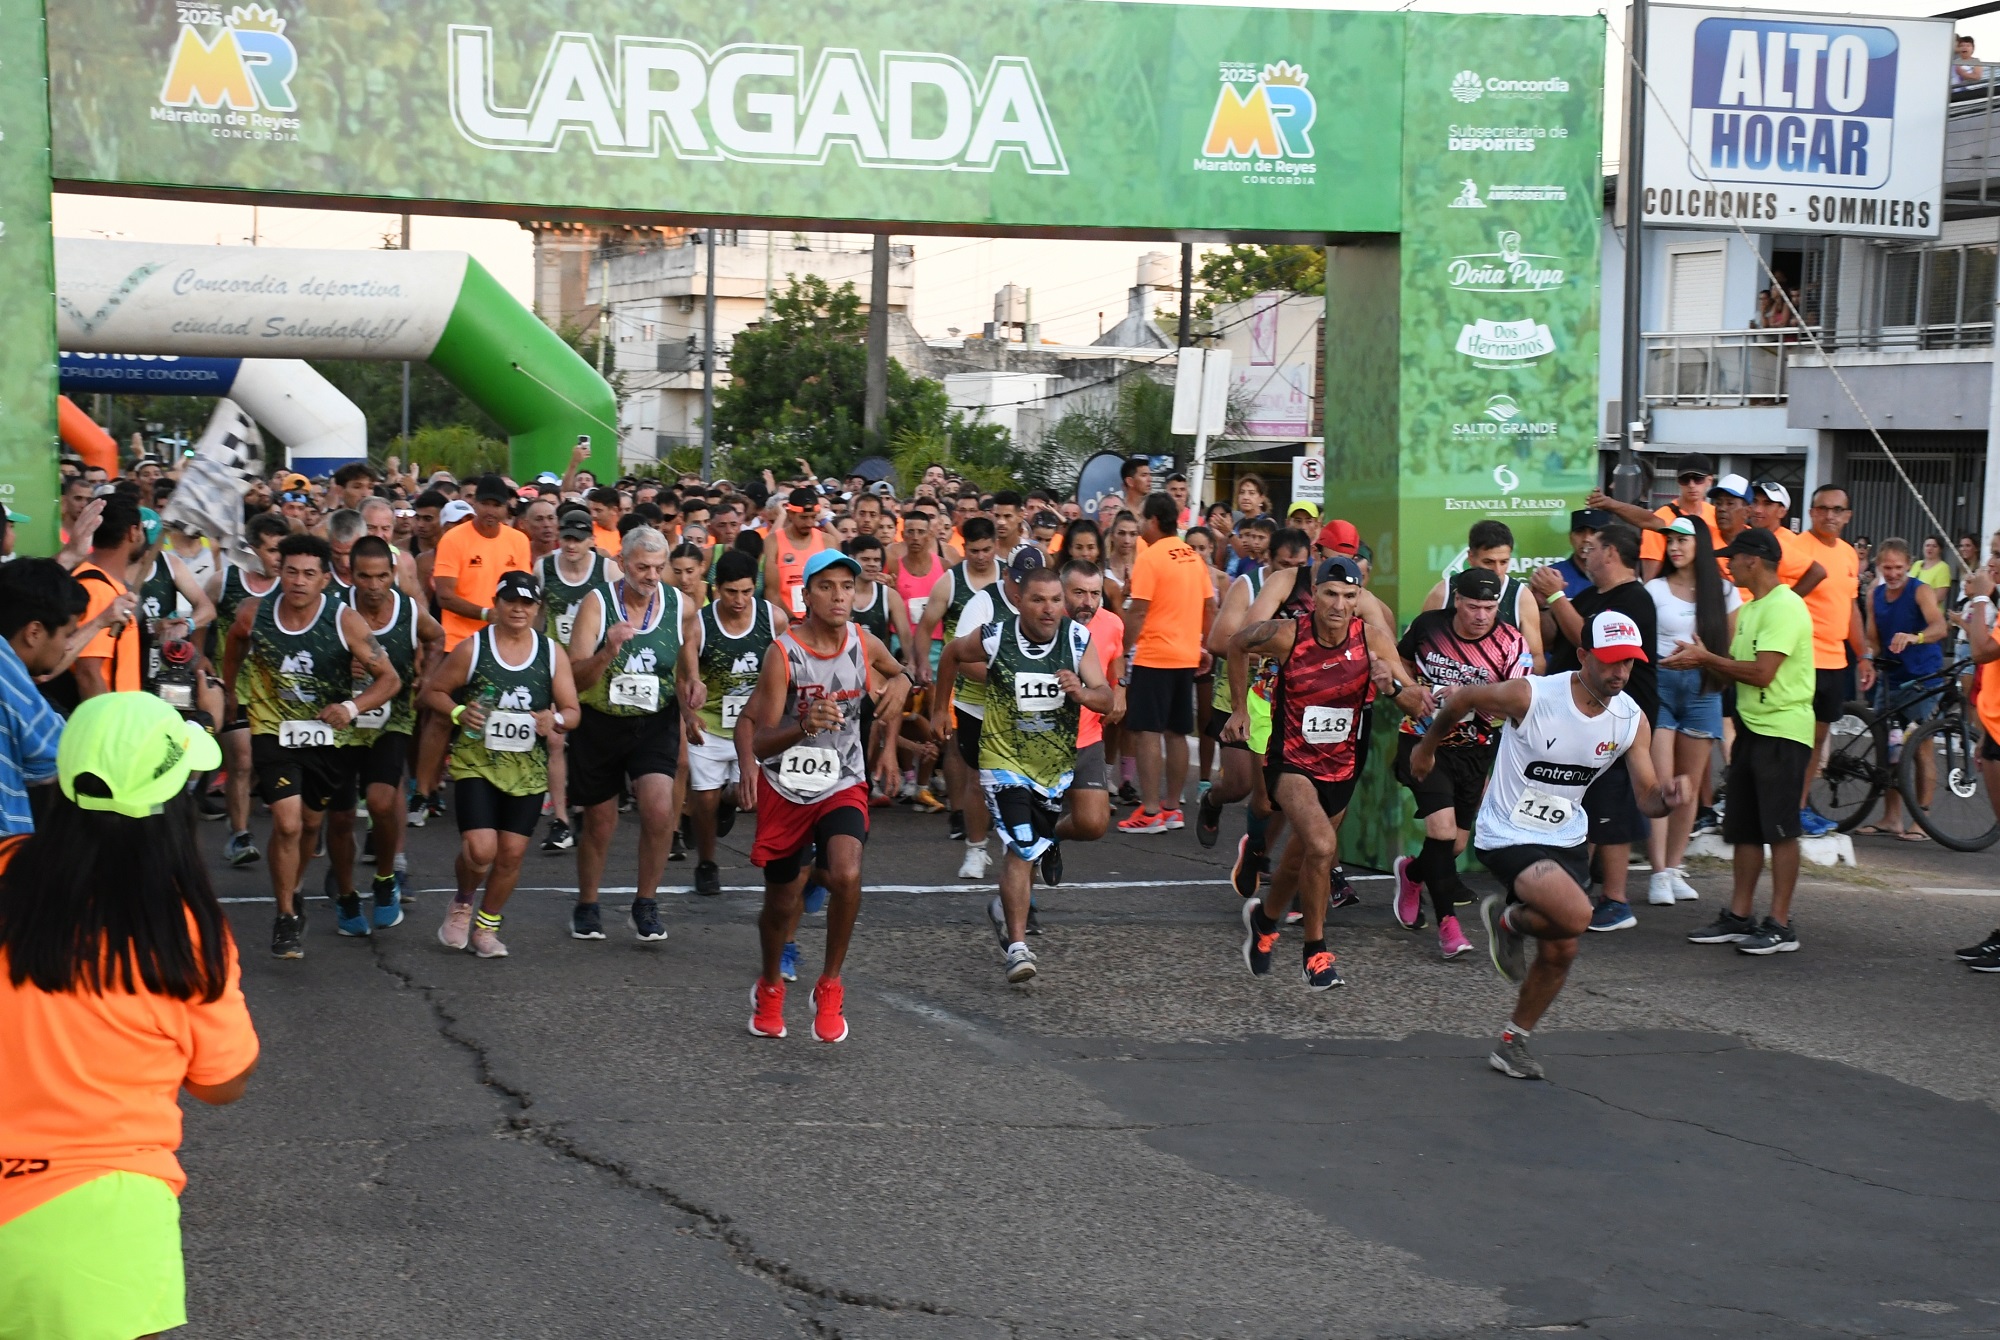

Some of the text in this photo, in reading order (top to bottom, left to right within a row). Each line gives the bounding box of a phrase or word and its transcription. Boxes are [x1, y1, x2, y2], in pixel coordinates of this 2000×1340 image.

[176, 9, 222, 25] 2025
[1219, 69, 1256, 82] 2025
[1718, 29, 1870, 113] ALTO
[1486, 77, 1569, 92] Concordia
[455, 33, 1059, 166] LARGADA
[150, 106, 300, 131] Maraton de Reyes
[211, 128, 299, 142] CONCORDIA
[1448, 124, 1568, 138] Subsecretaria de
[1448, 138, 1535, 151] DEPORTES
[1710, 112, 1870, 176] HOGAR
[1193, 159, 1316, 175] Maraton de Reyes
[1242, 175, 1315, 185] CONCORDIA
[1644, 187, 1777, 220] COLCHONES
[1808, 195, 1930, 228] SOMMIERS
[172, 268, 289, 296] Concordia
[1447, 260, 1565, 289] Doña Pupa
[171, 316, 253, 335] ciudad
[1494, 325, 1518, 338] Dos
[1469, 334, 1545, 356] Hermanos
[126, 368, 143, 379] DE
[147, 369, 219, 381] CONCORDIA
[1452, 422, 1558, 434] SALTO GRANDE
[1426, 651, 1489, 677] Atletas por la
[1021, 683, 1059, 698] 116
[491, 722, 530, 740] 106
[1307, 716, 1347, 732] 118
[285, 731, 326, 747] 120
[786, 756, 832, 777] 104
[1519, 800, 1565, 824] 119
